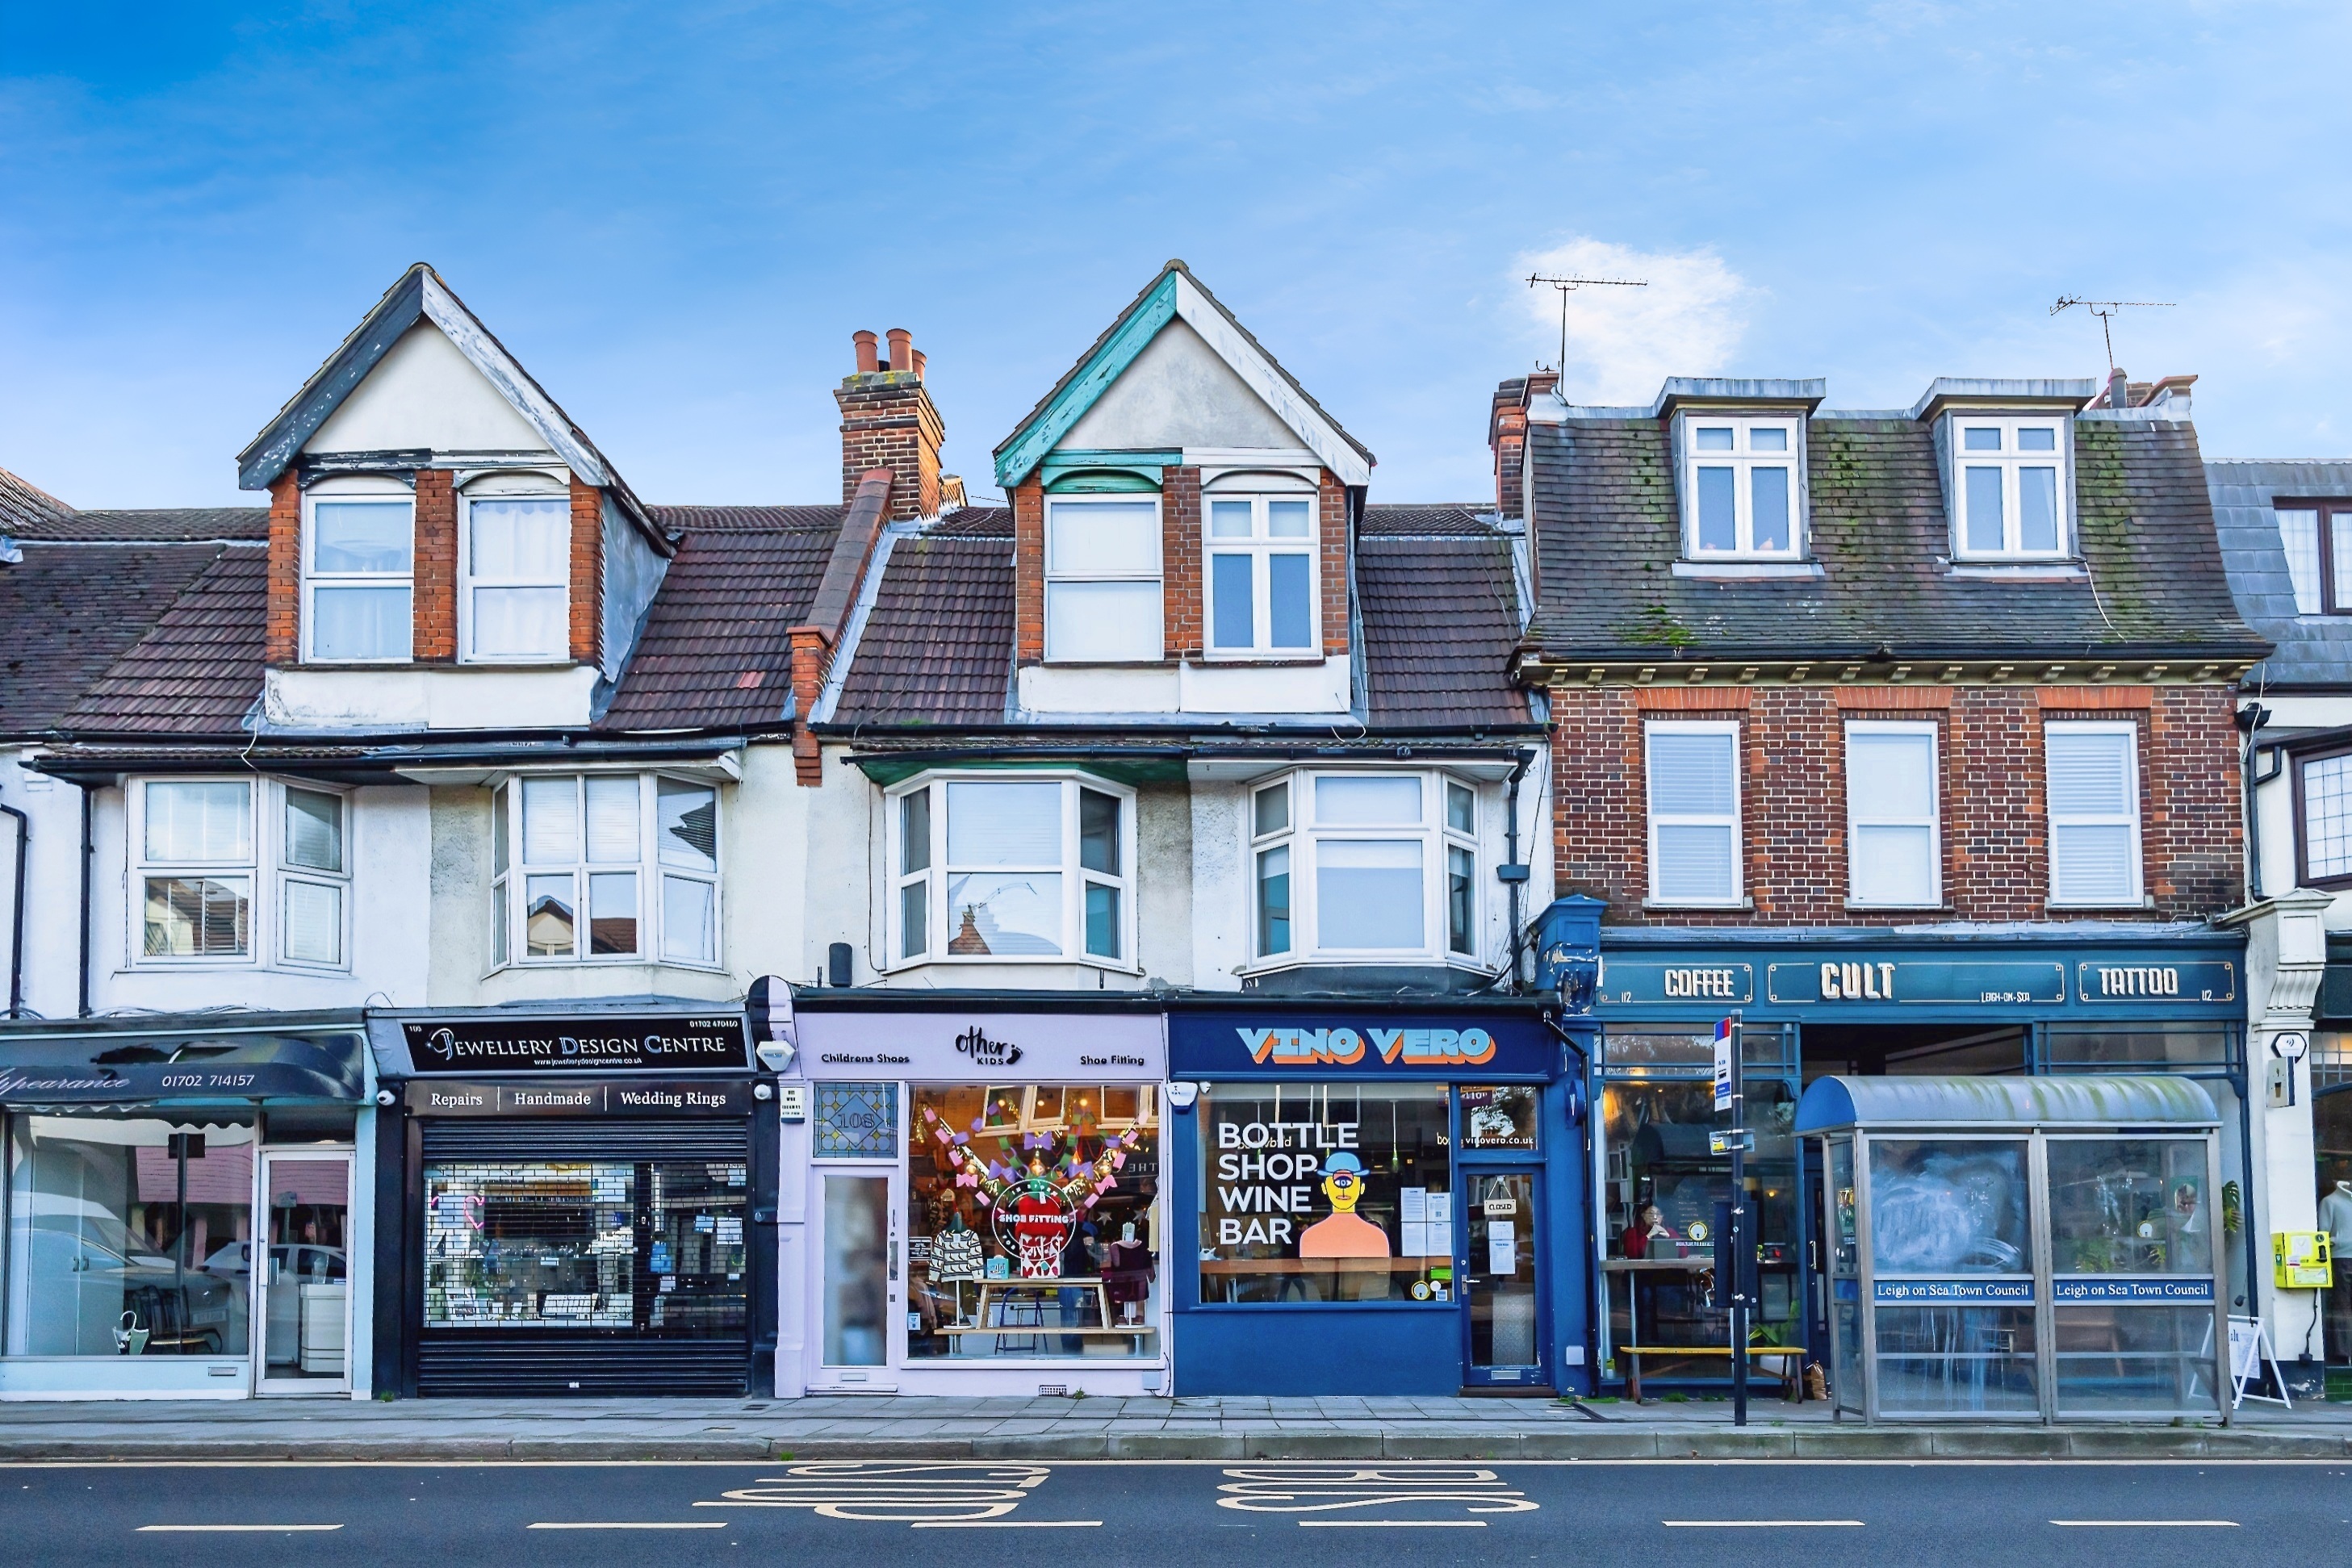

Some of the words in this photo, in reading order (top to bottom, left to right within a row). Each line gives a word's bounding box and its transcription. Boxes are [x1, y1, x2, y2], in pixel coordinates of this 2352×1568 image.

[1664, 969, 1735, 997] COFFEE
[1821, 962, 1896, 1000] CULT
[2098, 968, 2178, 995] TATTOO
[1621, 992, 1631, 1002] 112
[689, 1019, 711, 1028] 01702
[434, 1029, 552, 1060] JEWELLERY
[559, 1036, 638, 1056] DESIGN
[644, 1035, 726, 1053] CENTRE
[956, 1026, 1007, 1059] other
[1236, 1027, 1366, 1064] VINO
[1366, 1027, 1496, 1064] VERO
[822, 1054, 873, 1064] Childrens
[877, 1054, 910, 1064] Shoes
[977, 1057, 1004, 1066] KIDS
[1080, 1056, 1107, 1064] Shoe
[1111, 1055, 1145, 1066] Fitting
[162, 1076, 203, 1087] 01702
[209, 1074, 255, 1087] 714157
[431, 1093, 483, 1107] Repairs
[515, 1092, 591, 1106] Handmade
[621, 1092, 681, 1107] Wedding
[687, 1093, 726, 1106] Rings
[838, 1114, 875, 1128] 108
[1219, 1123, 1359, 1148] BOTTLE
[1217, 1153, 1318, 1181] SHOP
[1217, 1186, 1312, 1213] WINE
[999, 1215, 1026, 1223] SHOE
[1220, 1218, 1291, 1245] BAR
[1877, 1285, 1909, 1298] Leigh
[1912, 1286, 1927, 1295] on
[1929, 1285, 1949, 1295] Sea
[1952, 1285, 1982, 1295] Town
[1986, 1285, 2028, 1295] Council
[2057, 1285, 2088, 1298] Leigh
[2090, 1286, 2105, 1295] on
[2108, 1285, 2128, 1295] Sea
[2130, 1285, 2162, 1295] Town
[2165, 1285, 2208, 1295] Council
